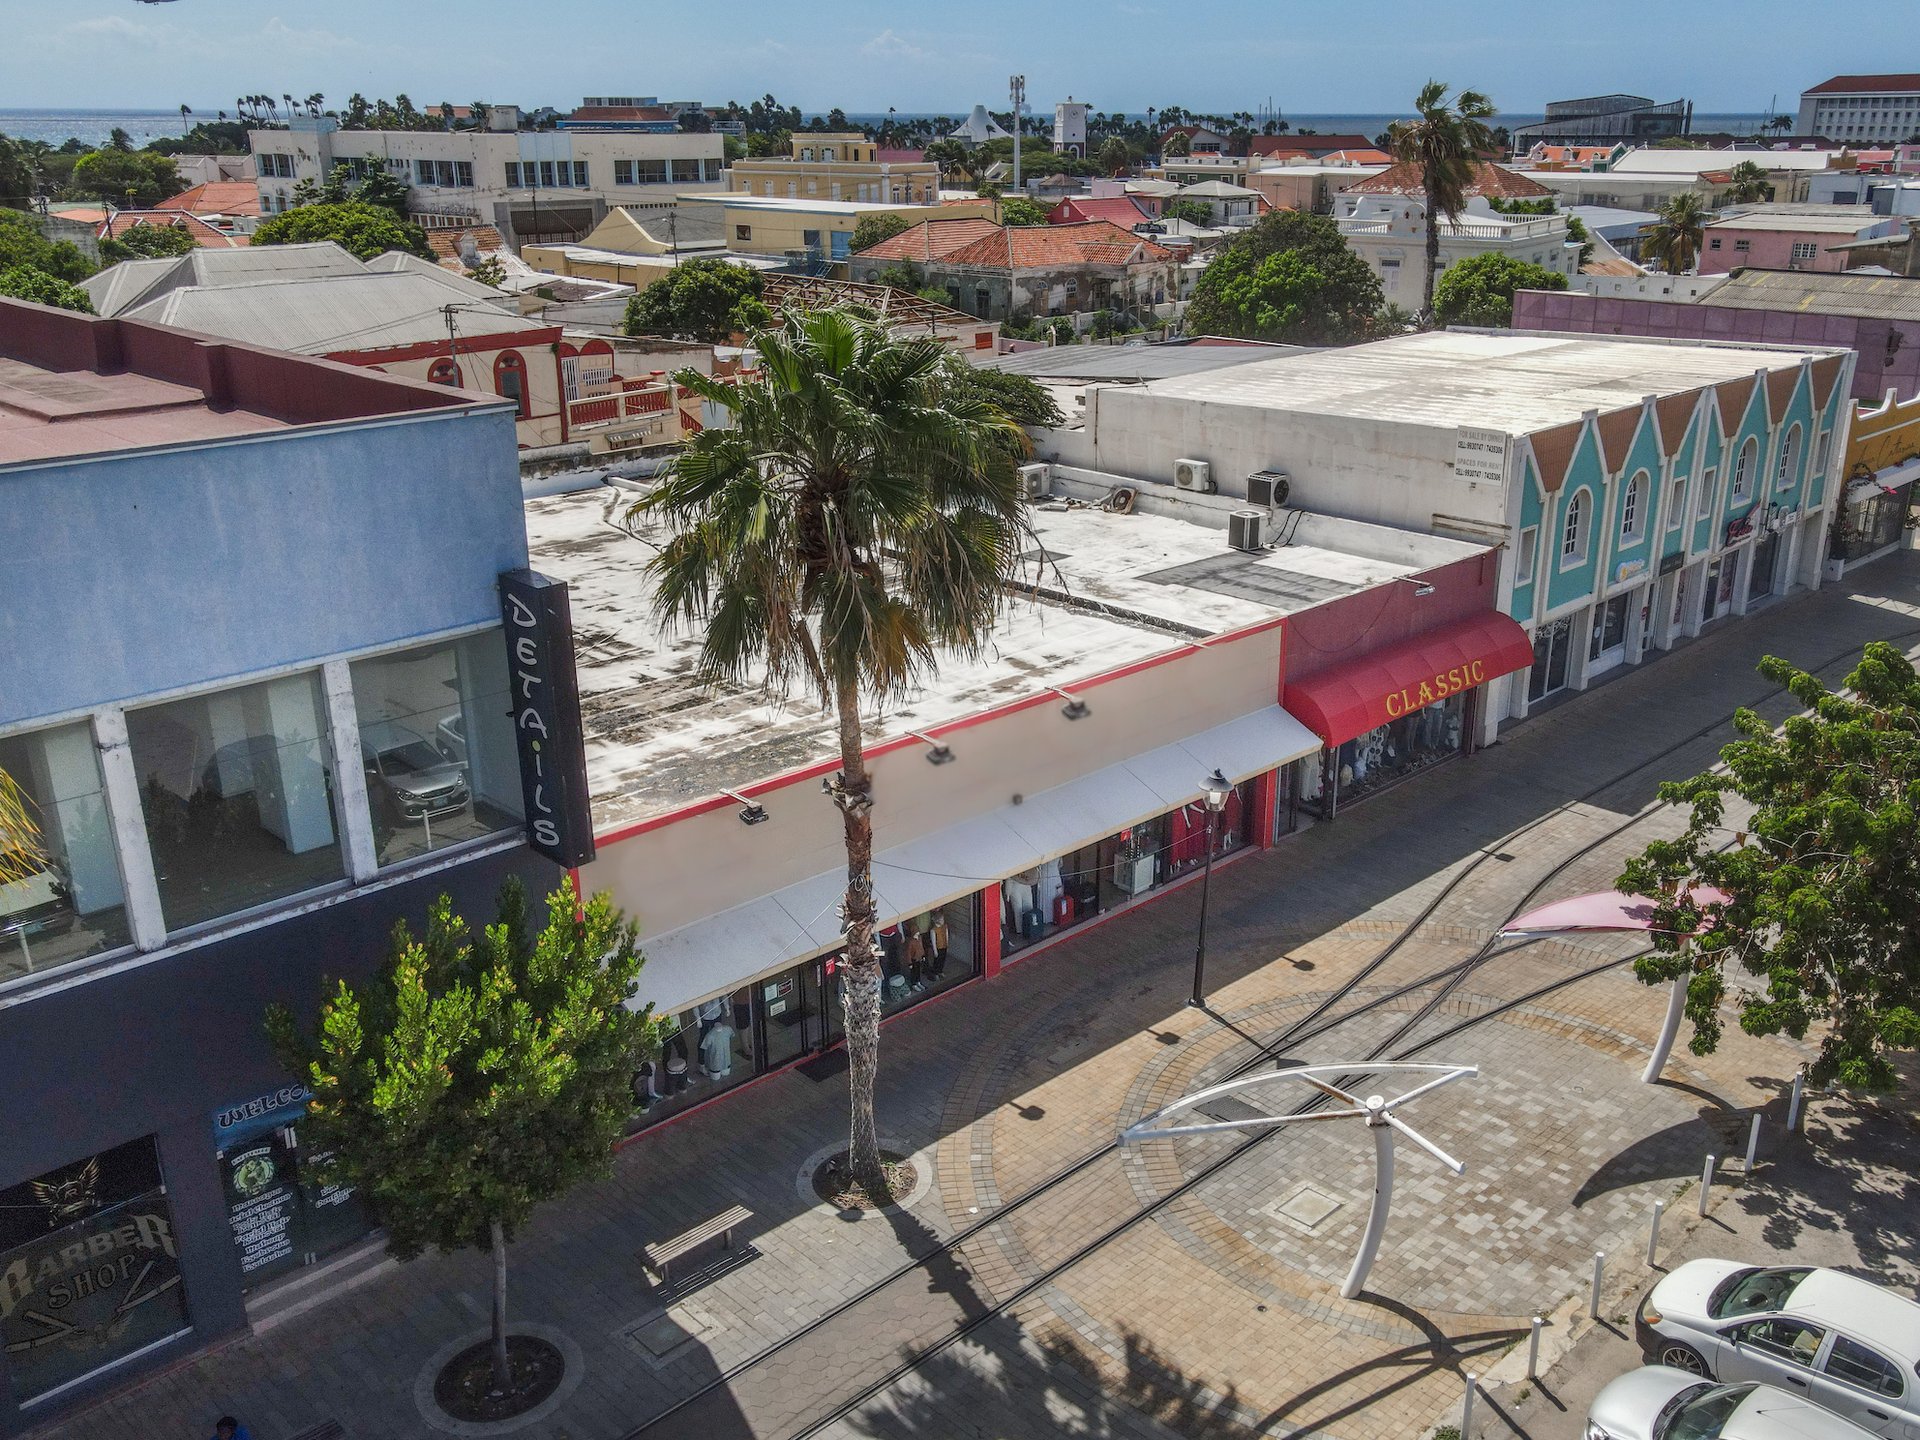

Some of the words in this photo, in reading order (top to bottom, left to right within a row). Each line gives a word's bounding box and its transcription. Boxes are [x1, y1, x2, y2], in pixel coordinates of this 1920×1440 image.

[1385, 660, 1485, 717] CLASSIC
[218, 1083, 312, 1128] WELCO
[47, 1254, 136, 1309] SHOP
